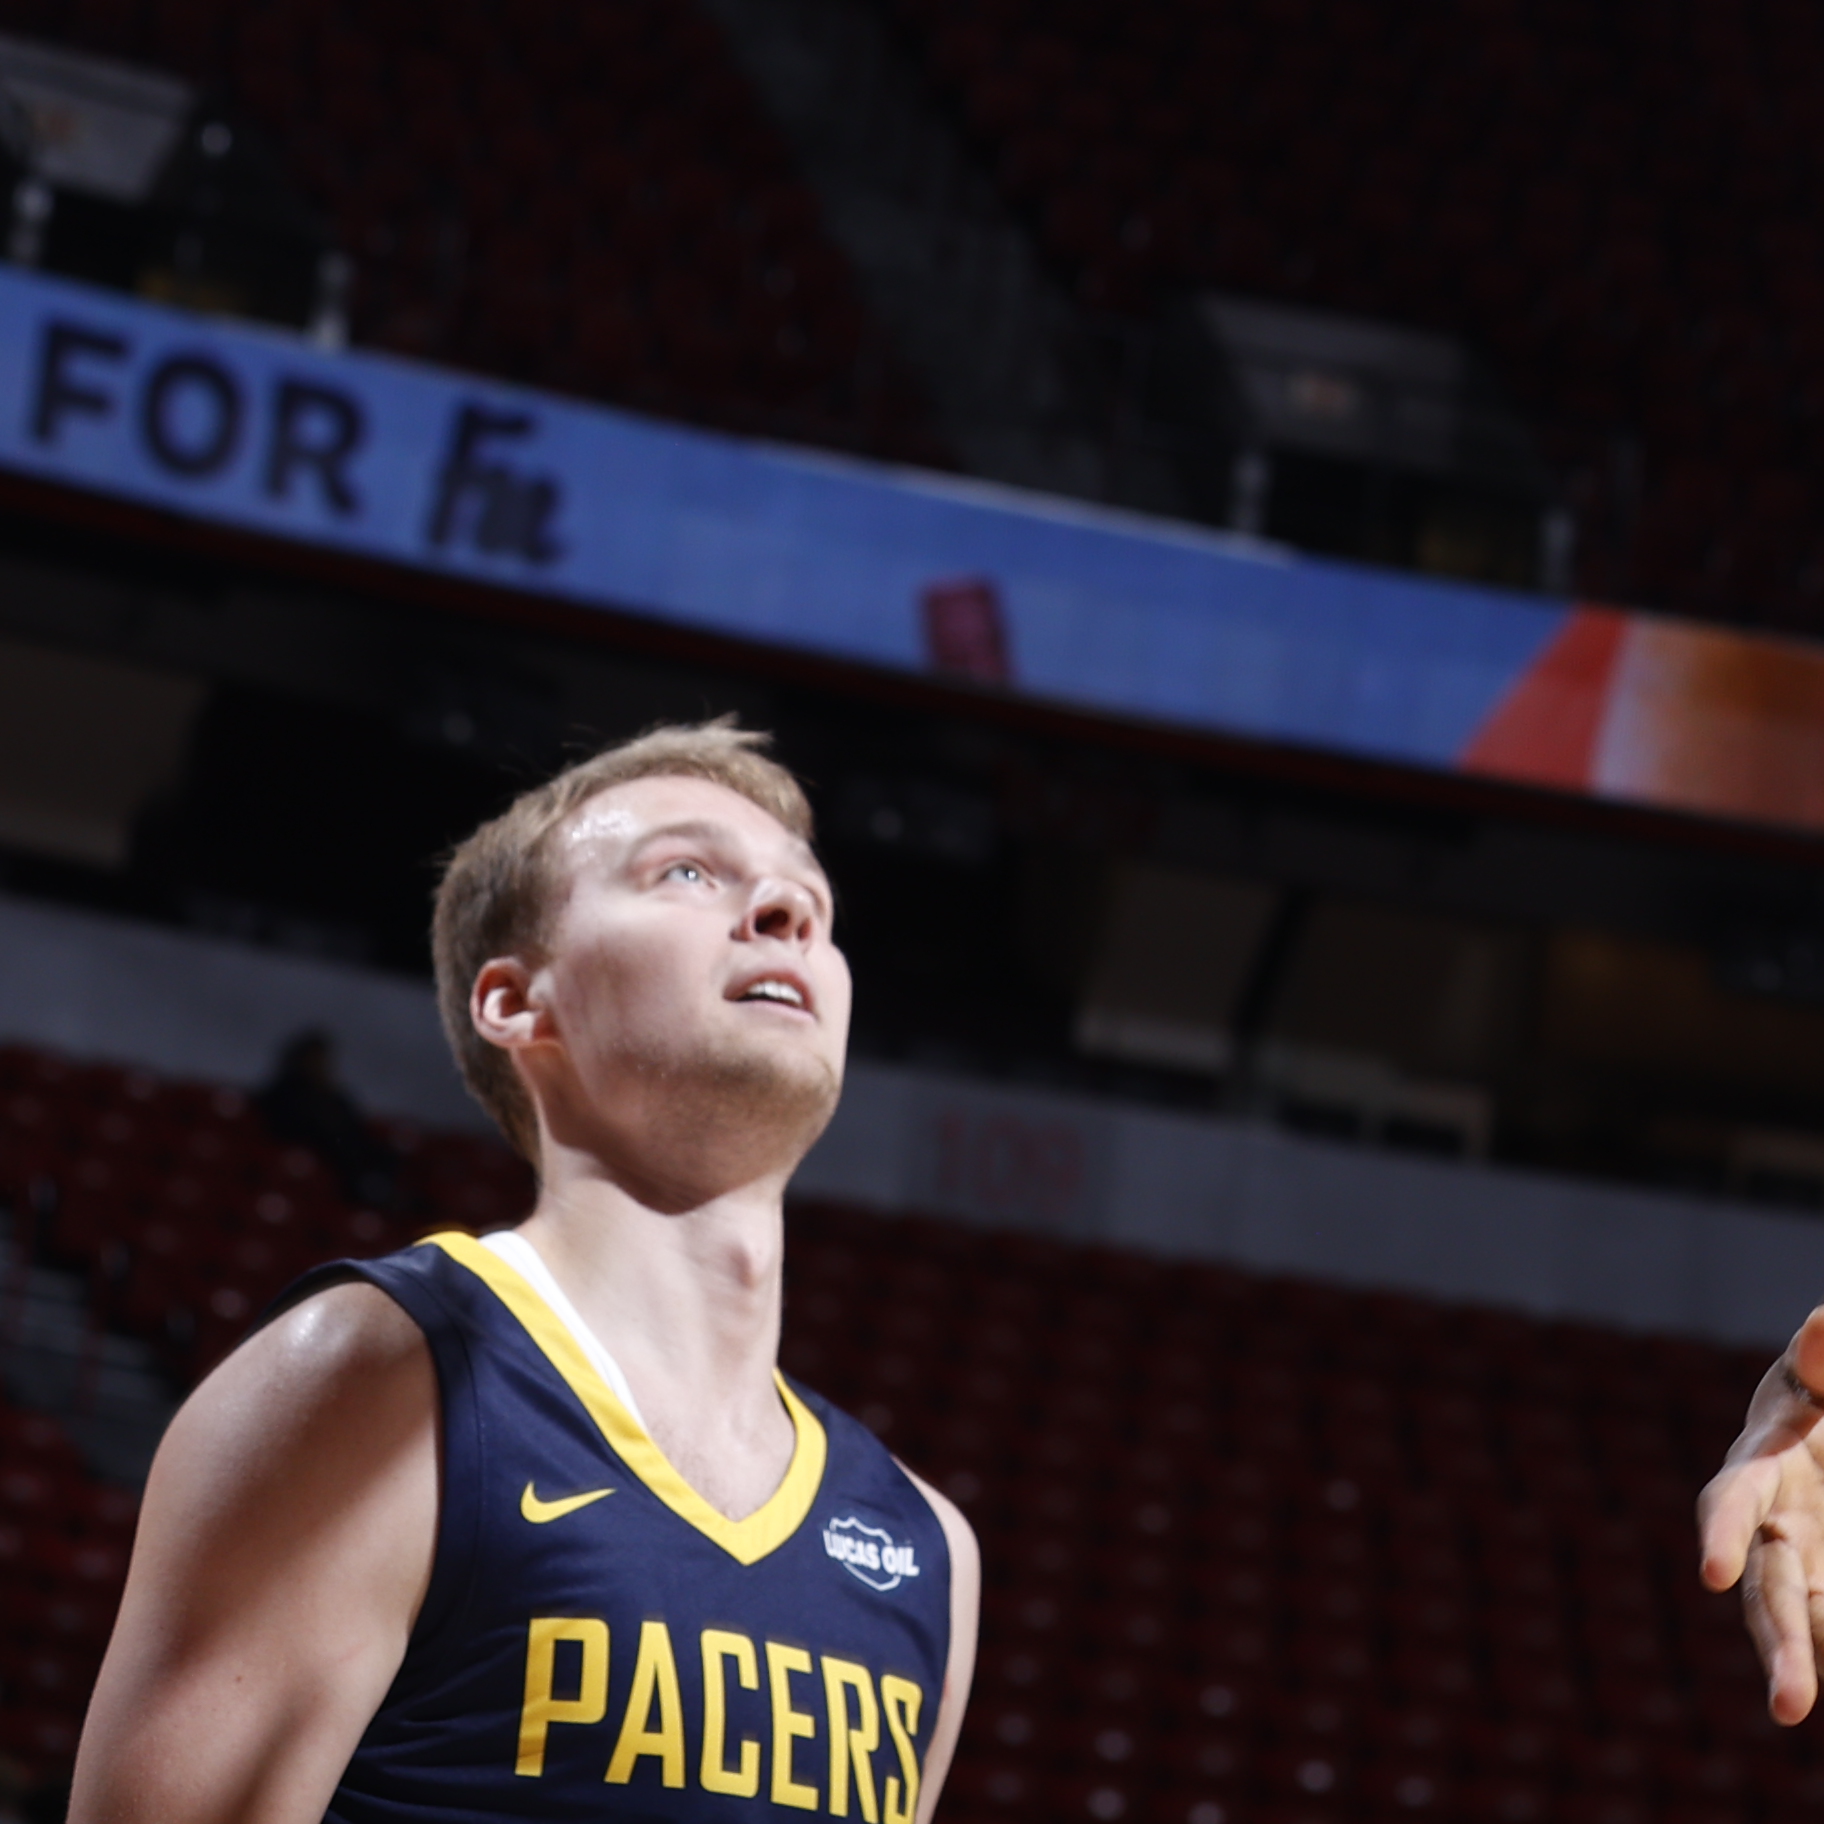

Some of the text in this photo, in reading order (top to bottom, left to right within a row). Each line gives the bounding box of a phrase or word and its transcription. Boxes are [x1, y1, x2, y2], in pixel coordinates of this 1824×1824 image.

[30, 318, 370, 518] FOR
[822, 1528, 921, 1577] LUCAS OIL
[514, 1617, 923, 1824] PACERS
